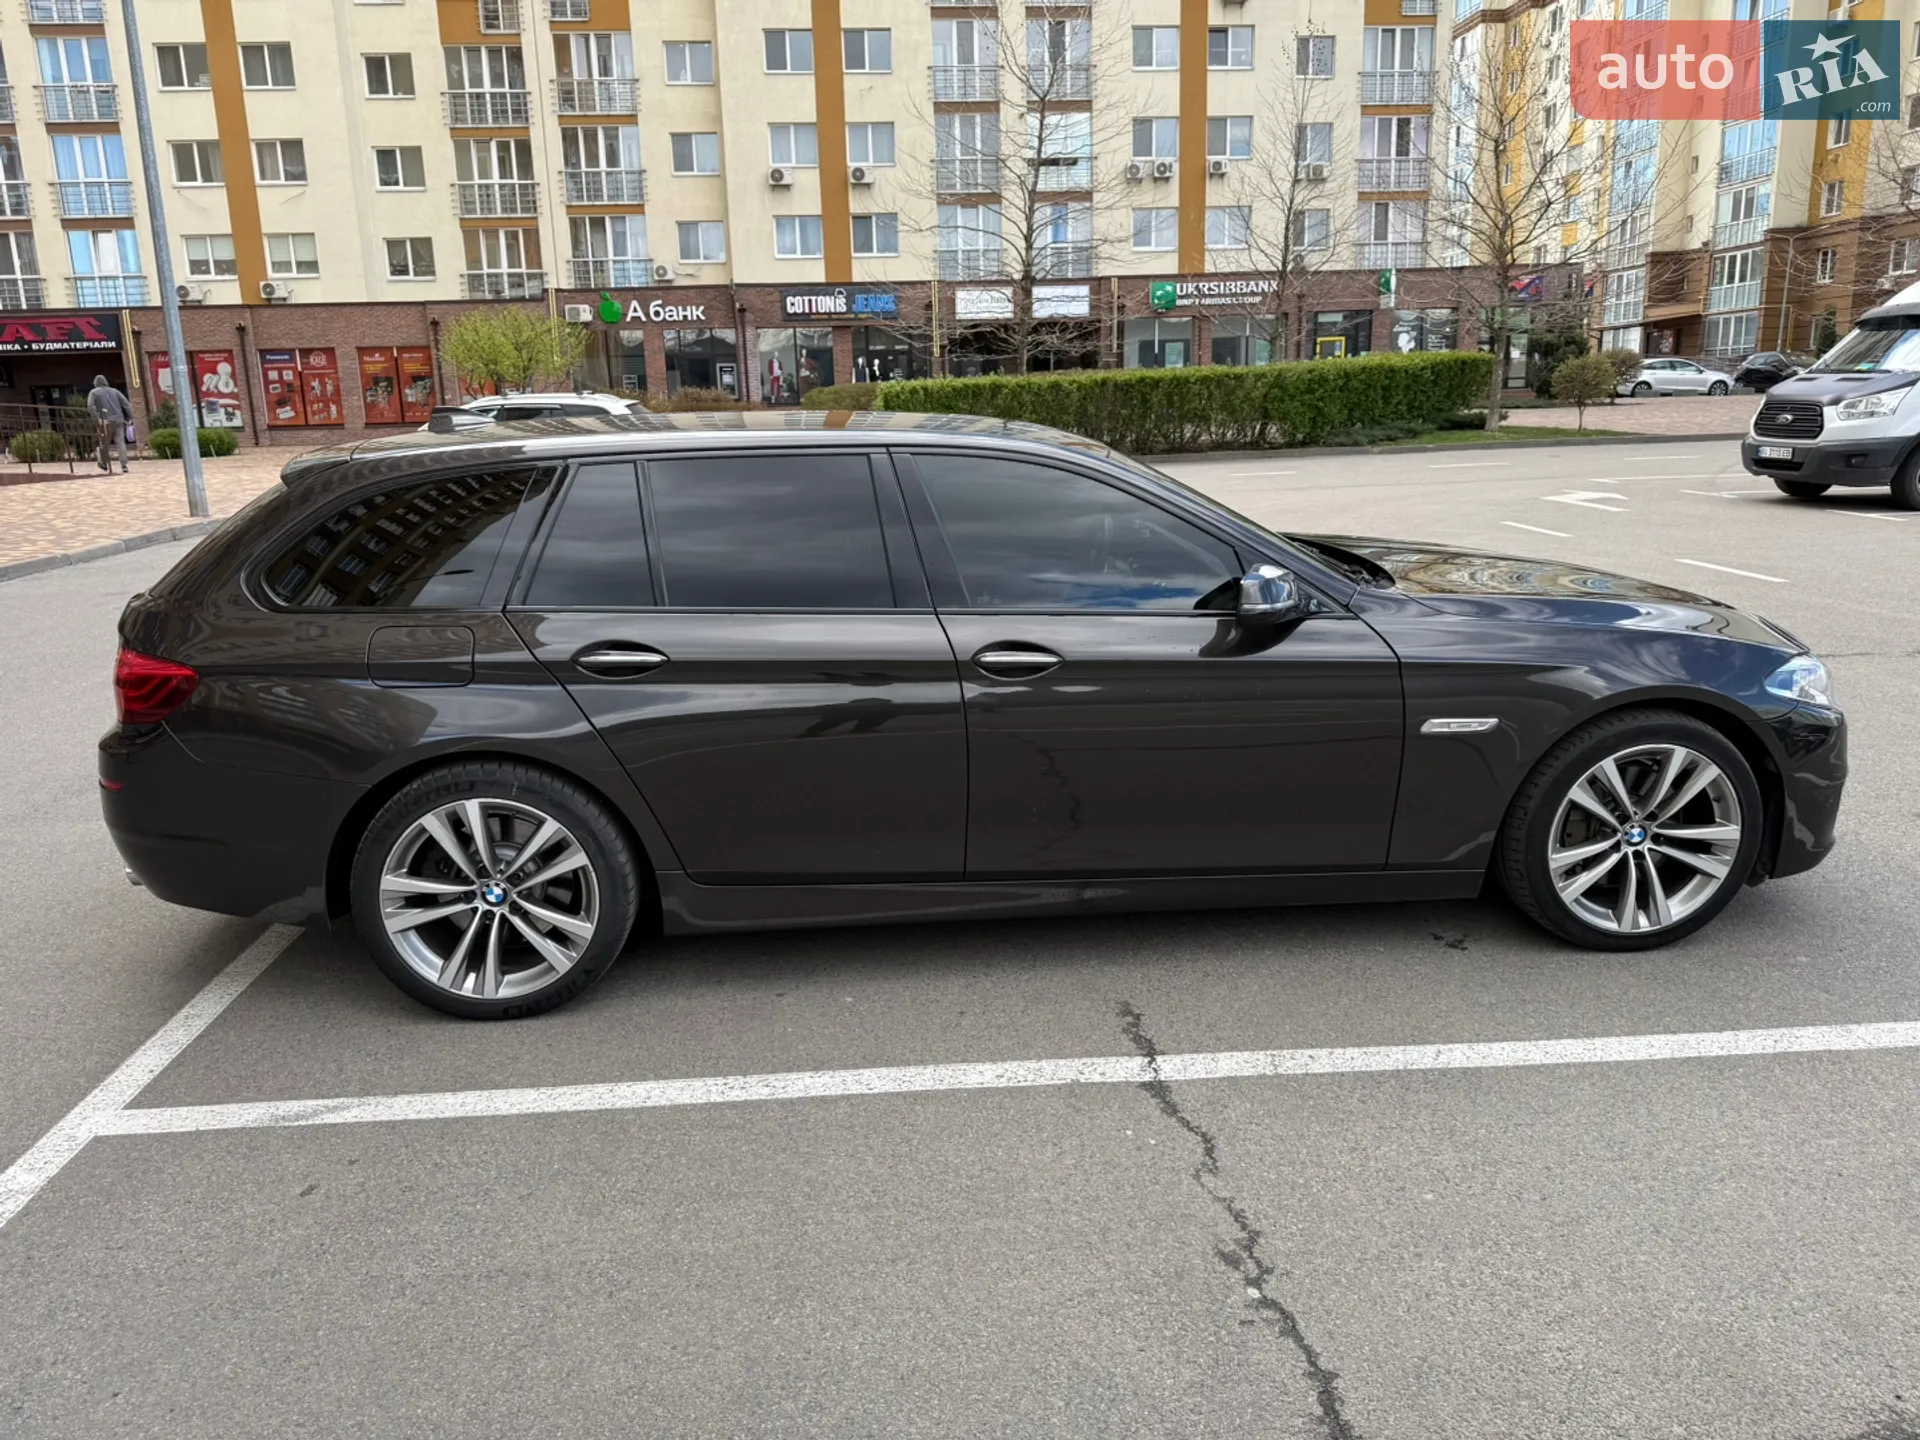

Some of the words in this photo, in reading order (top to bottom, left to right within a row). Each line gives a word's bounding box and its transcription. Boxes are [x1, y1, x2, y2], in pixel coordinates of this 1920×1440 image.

[1176, 280, 1278, 295] UKRSIBBANK
[649, 300, 706, 321] банк
[786, 296, 834, 314] COTTON
[852, 294, 896, 313] JEANS
[32, 341, 116, 350] БУДМАТЕРІАЛИ
